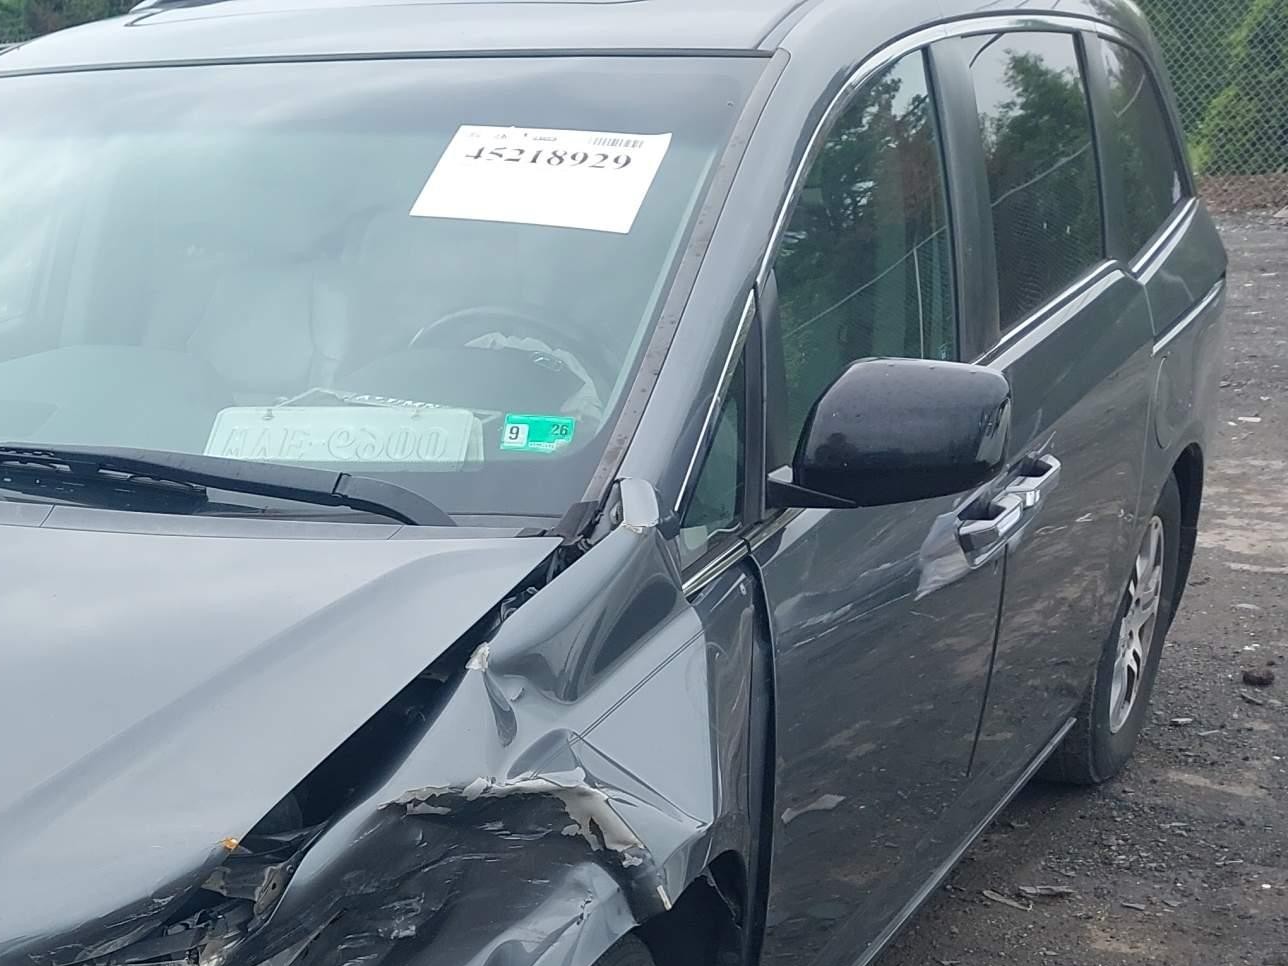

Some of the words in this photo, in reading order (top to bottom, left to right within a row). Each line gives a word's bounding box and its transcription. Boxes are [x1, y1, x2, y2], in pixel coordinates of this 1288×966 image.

[464, 145, 633, 171] 45218929
[508, 425, 521, 441] 9
[552, 423, 570, 437] 26
